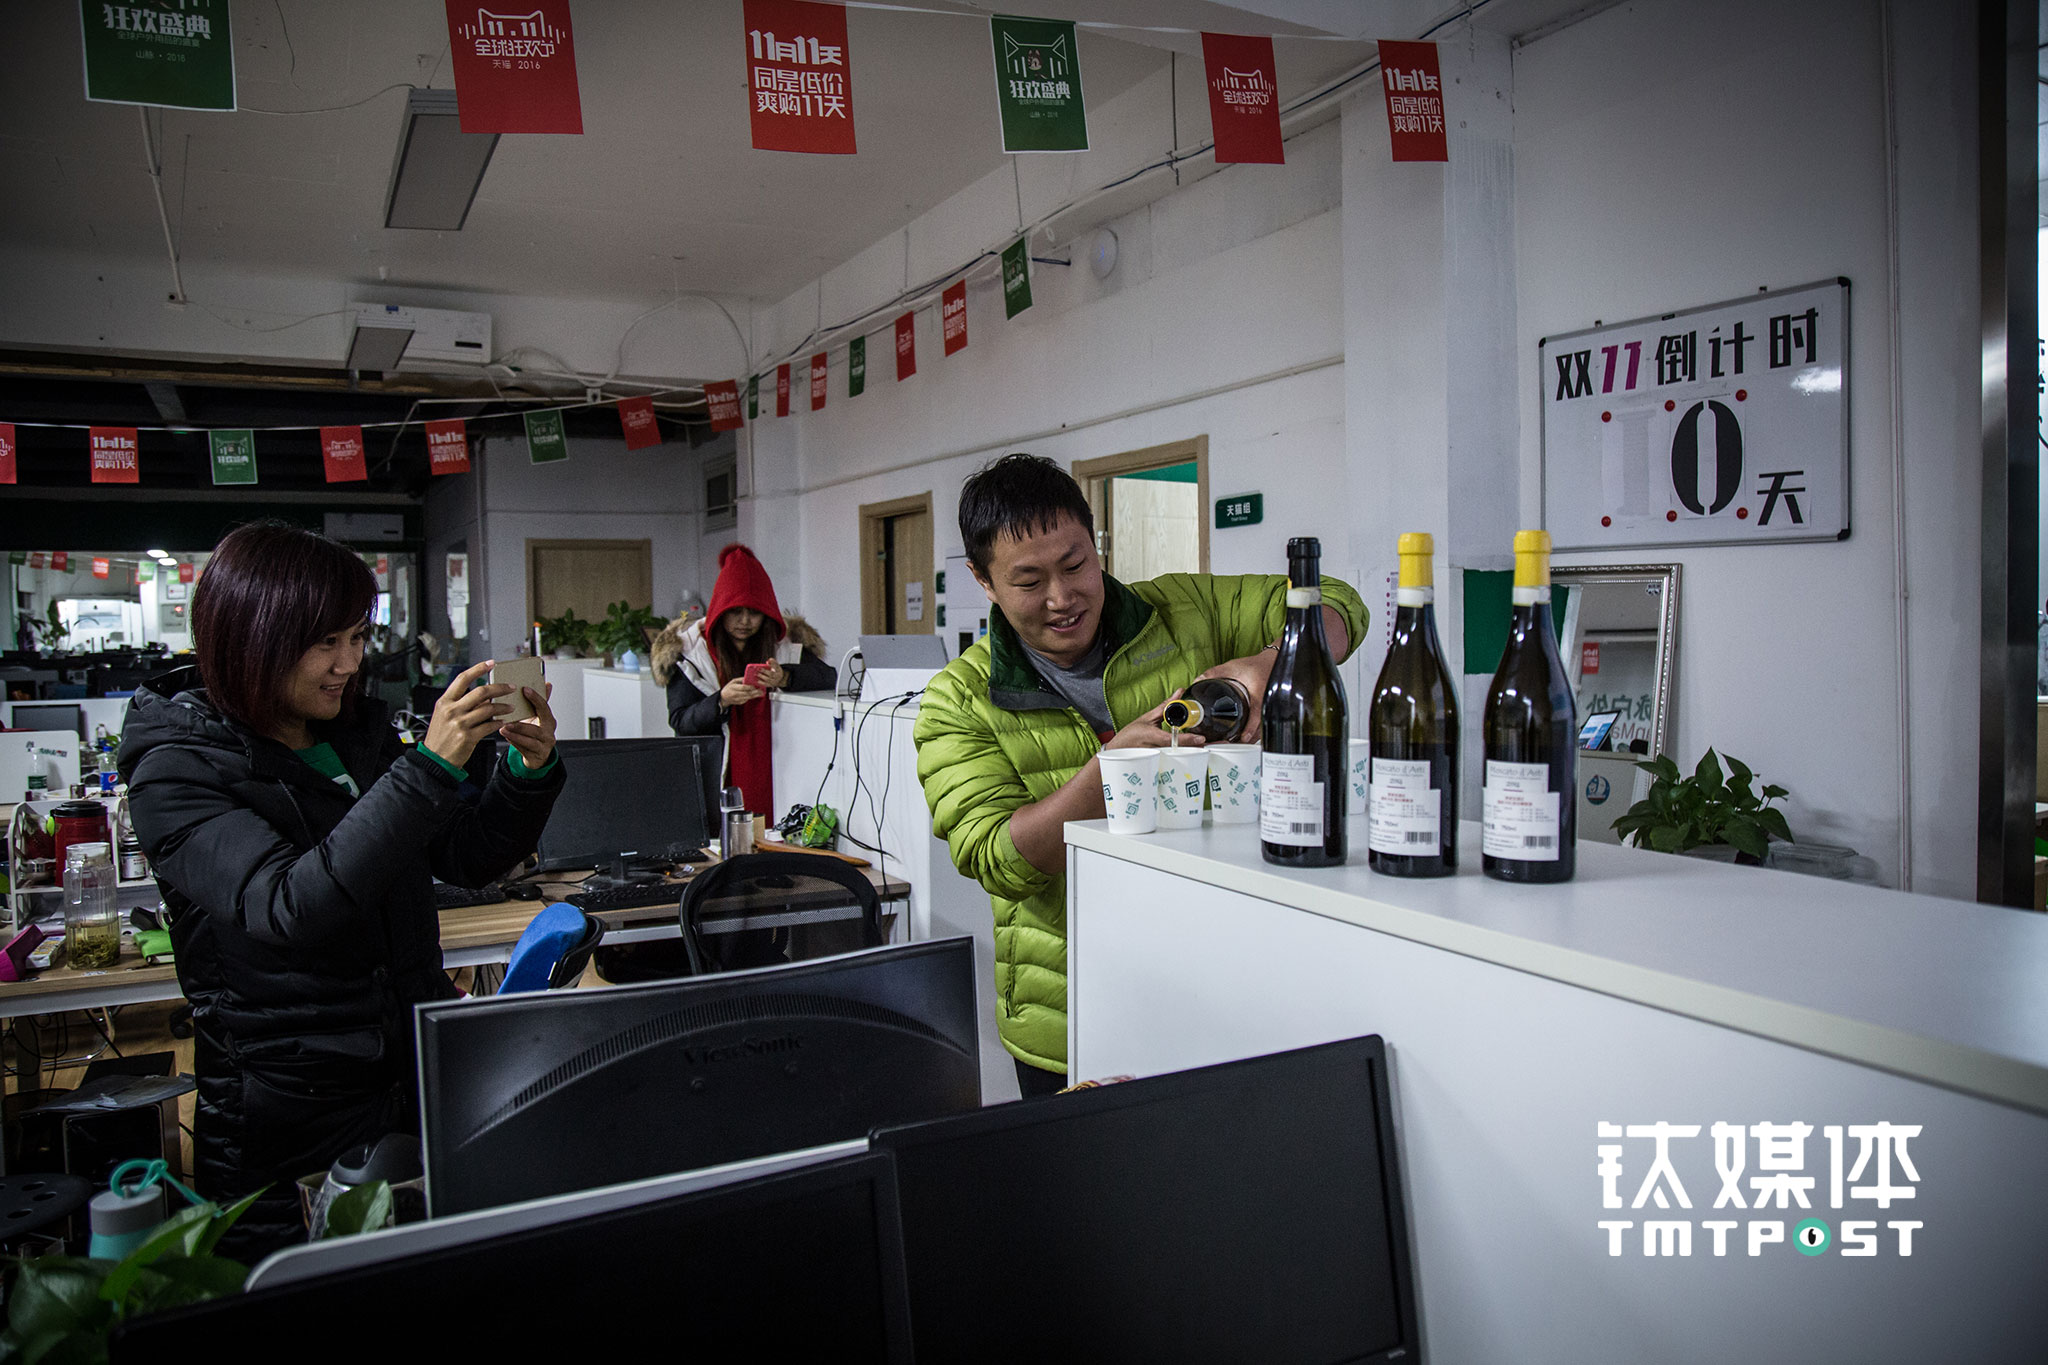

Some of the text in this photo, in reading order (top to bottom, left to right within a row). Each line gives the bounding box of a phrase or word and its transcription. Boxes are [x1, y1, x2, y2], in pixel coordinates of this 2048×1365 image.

[103, 4, 211, 39] 狂欢盛典
[487, 21, 537, 37] 11.11
[475, 39, 555, 57] 全球狂欢节
[493, 60, 541, 70] 天猫 2016
[754, 66, 843, 95] 同是低价
[1009, 79, 1071, 99] 狂欢盛典
[756, 91, 846, 118] 爽购11天
[1390, 96, 1441, 115] 同是低价
[1393, 115, 1443, 133] 爽购11天
[1226, 502, 1251, 517] 天猫组
